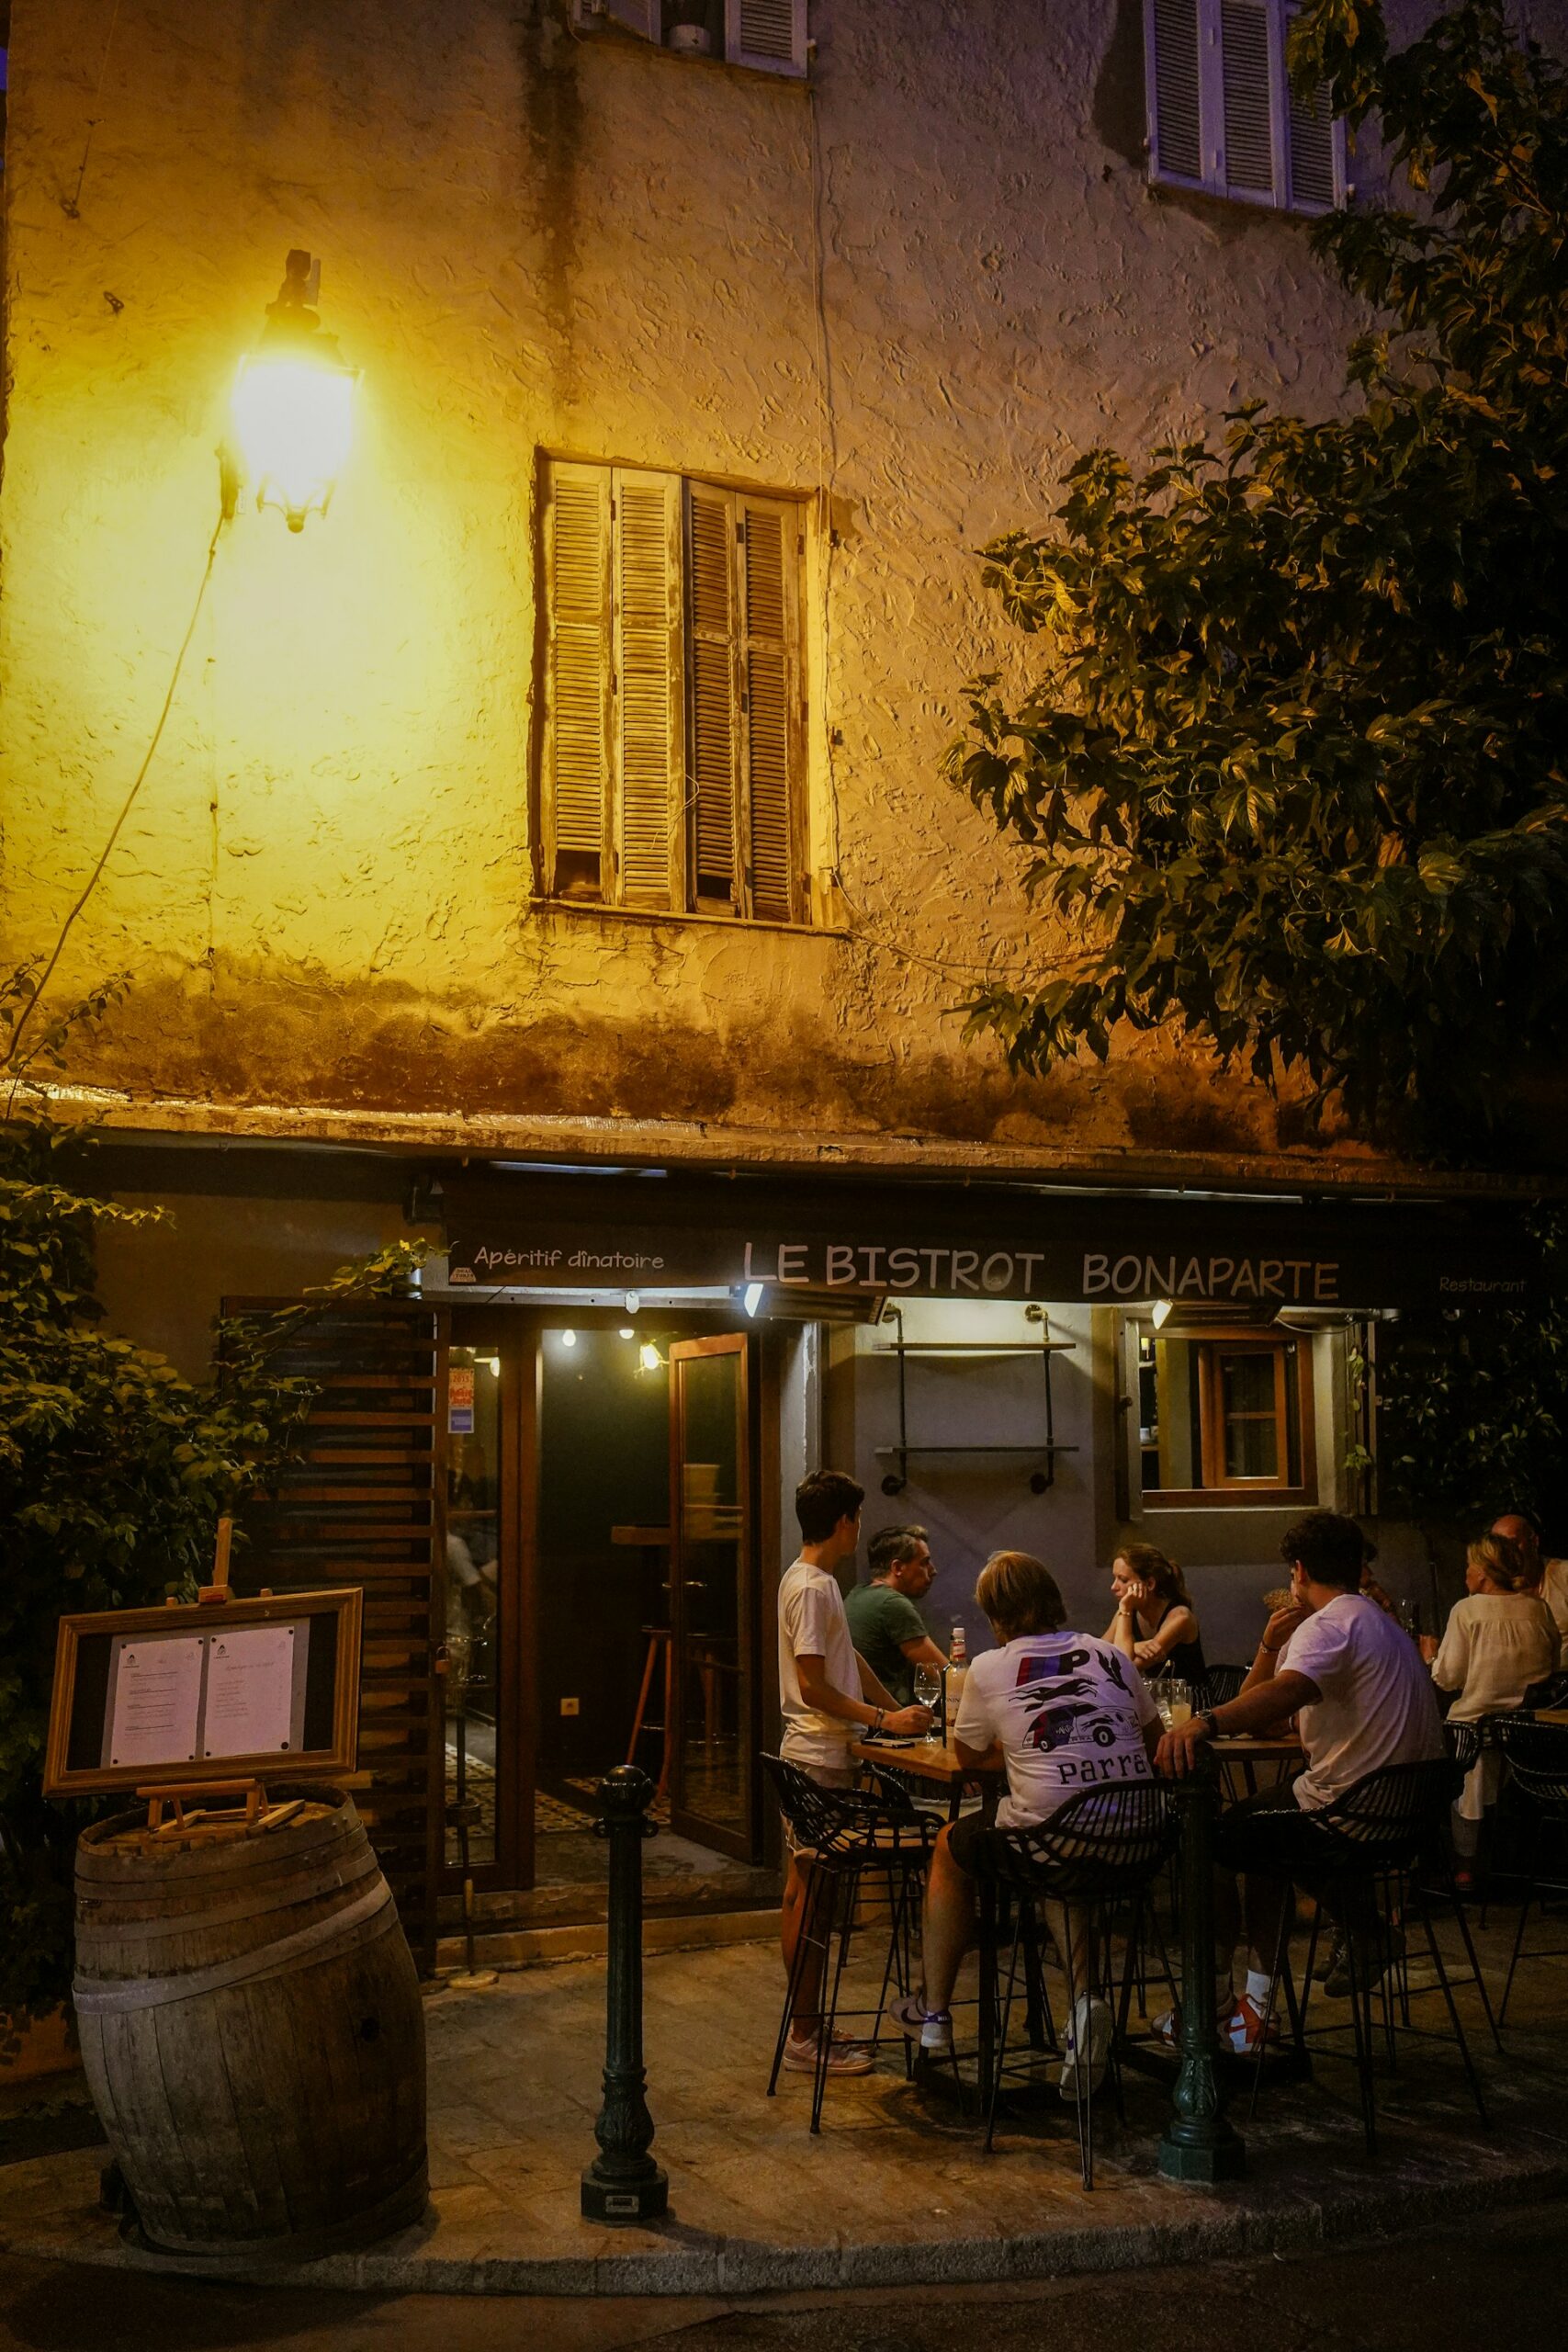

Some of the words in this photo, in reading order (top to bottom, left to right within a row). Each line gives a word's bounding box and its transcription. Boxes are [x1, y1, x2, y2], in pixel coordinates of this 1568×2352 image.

[474, 1246, 563, 1271] Apéritif
[568, 1250, 665, 1269] dînatoire
[744, 1241, 810, 1283] LE
[827, 1245, 1045, 1294] BISTROT
[1083, 1253, 1339, 1301] BONAPARTE
[1438, 1276, 1528, 1294] Restaurant
